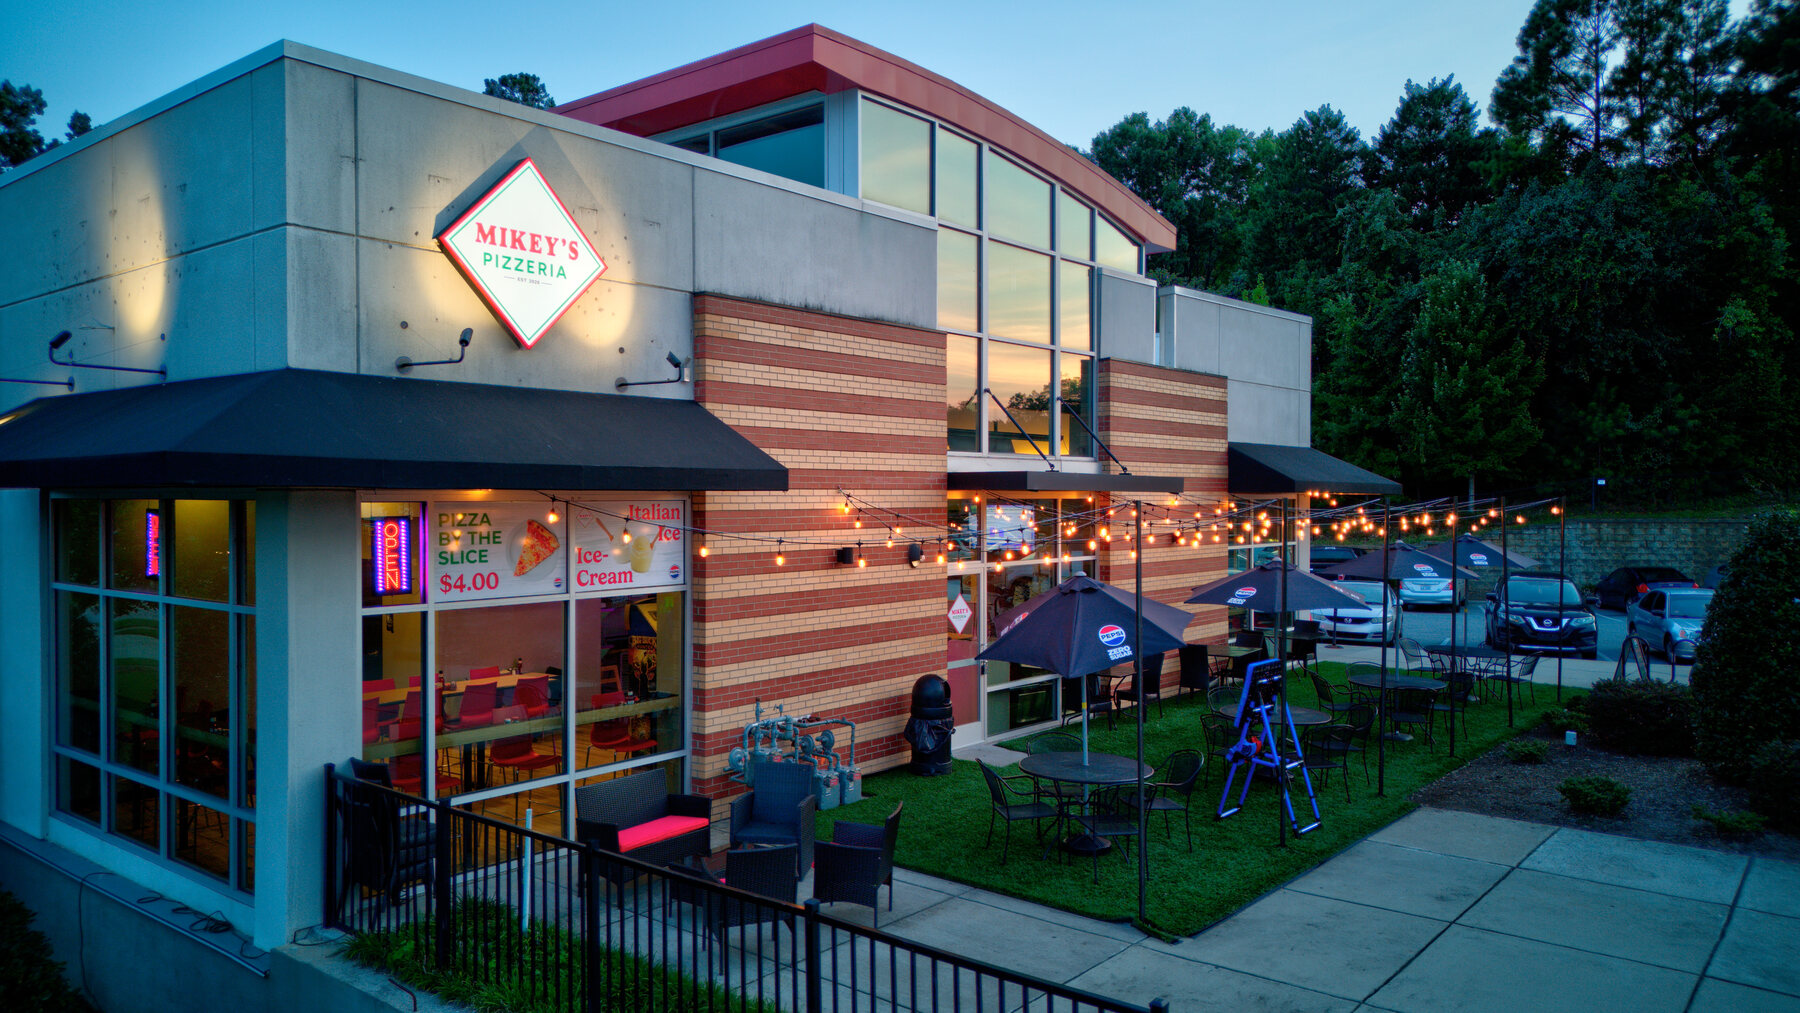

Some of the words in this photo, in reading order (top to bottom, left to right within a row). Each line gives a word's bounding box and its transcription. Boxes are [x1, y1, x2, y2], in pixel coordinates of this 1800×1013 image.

[475, 222, 579, 260] MIKEY'S
[483, 252, 567, 279] PIZZERIA
[438, 512, 492, 527] PIZZA
[628, 504, 681, 520] Italian
[438, 531, 464, 546] BY
[467, 531, 502, 545] THE
[658, 525, 681, 541] Ice
[384, 523, 399, 590] OPEN
[438, 549, 489, 565] SLICE
[576, 547, 609, 564] Ice-
[439, 572, 499, 595] $4.00
[576, 569, 634, 587] Cream
[1100, 630, 1124, 640] PEPSI
[1107, 645, 1131, 656] ZERO
[1109, 650, 1133, 660] SUGAR
